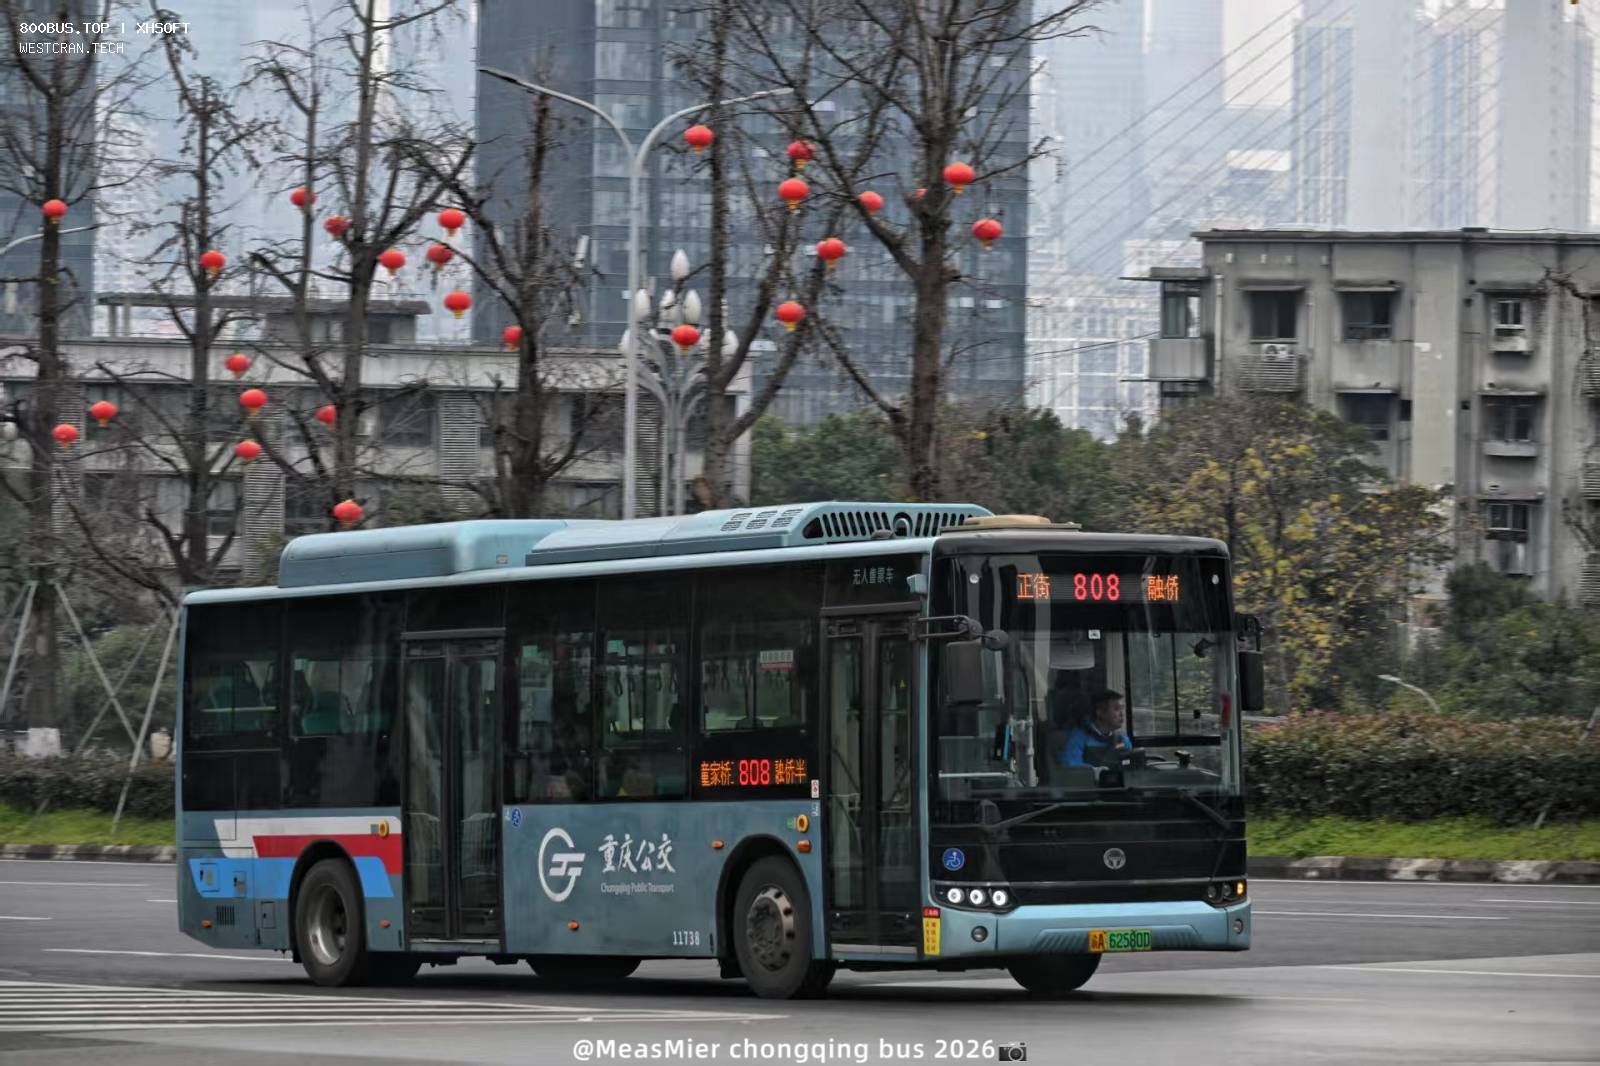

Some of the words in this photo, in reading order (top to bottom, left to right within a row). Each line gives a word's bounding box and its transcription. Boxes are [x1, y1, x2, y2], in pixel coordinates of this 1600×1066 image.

[1016, 573, 1050, 600] 正街
[1073, 572, 1120, 601] 808
[739, 759, 770, 786] 808
[598, 833, 677, 873] 重庆公交
[600, 882, 631, 896] Chongqing
[672, 930, 700, 946] 11738
